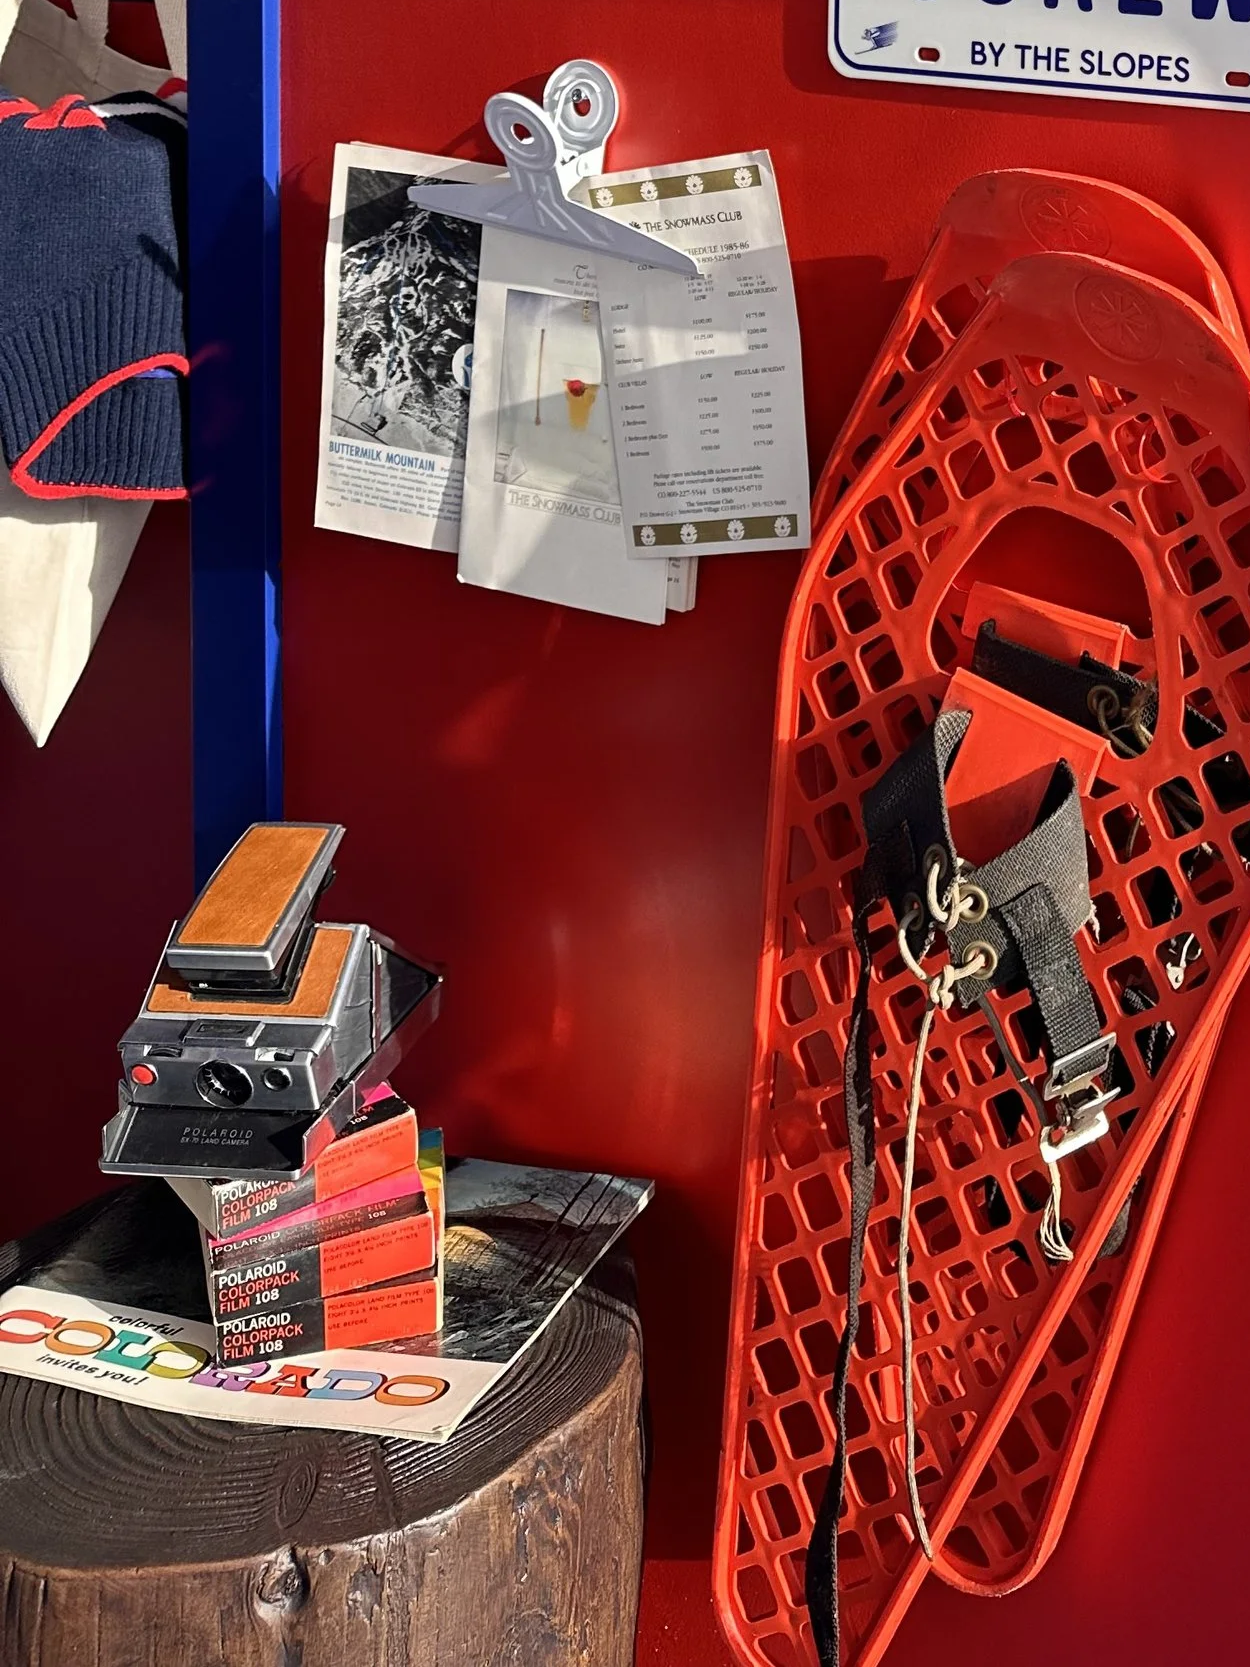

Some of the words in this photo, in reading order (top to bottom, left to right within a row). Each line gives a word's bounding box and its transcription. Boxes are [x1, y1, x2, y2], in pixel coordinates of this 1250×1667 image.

[971, 41, 1006, 66] BY
[1014, 44, 1070, 73] THE
[1080, 49, 1190, 82] SLOPES
[643, 222, 662, 233] THE
[684, 243, 719, 255] HEDULE
[329, 441, 382, 462] BUTTERMILK
[385, 452, 436, 472] MOUNTAIN
[508, 490, 530, 506] THE
[350, 1115, 369, 1125] 108
[183, 1127, 254, 1139] POLAROID
[201, 1137, 220, 1145] LAND
[221, 1138, 250, 1146] CAMERA
[221, 1180, 279, 1204] POLARO
[222, 1181, 296, 1217] COLORPACK
[223, 1211, 251, 1230] FILM
[255, 1198, 278, 1217] 108
[368, 1210, 387, 1220] 108
[215, 1231, 280, 1255] POLAROID
[362, 1235, 380, 1244] LAND
[396, 1232, 418, 1242] PRINTS
[218, 1260, 287, 1289] POLAROID
[339, 1258, 364, 1270] BEFORE
[219, 1270, 300, 1302] COLORPACK
[220, 1296, 250, 1314] FILM
[255, 1288, 279, 1305] 108
[368, 1296, 385, 1304] LAND
[401, 1297, 423, 1306] PRINTS
[108, 1314, 186, 1336] colorful
[223, 1312, 291, 1335] POLAROID
[343, 1318, 368, 1327] BEFORE
[222, 1323, 303, 1348] COLORPACK
[0, 1309, 450, 1407] COLORADO
[224, 1345, 254, 1360] FILM
[259, 1339, 284, 1354] 108
[36, 1353, 98, 1374] invites
[95, 1369, 150, 1386] you!
